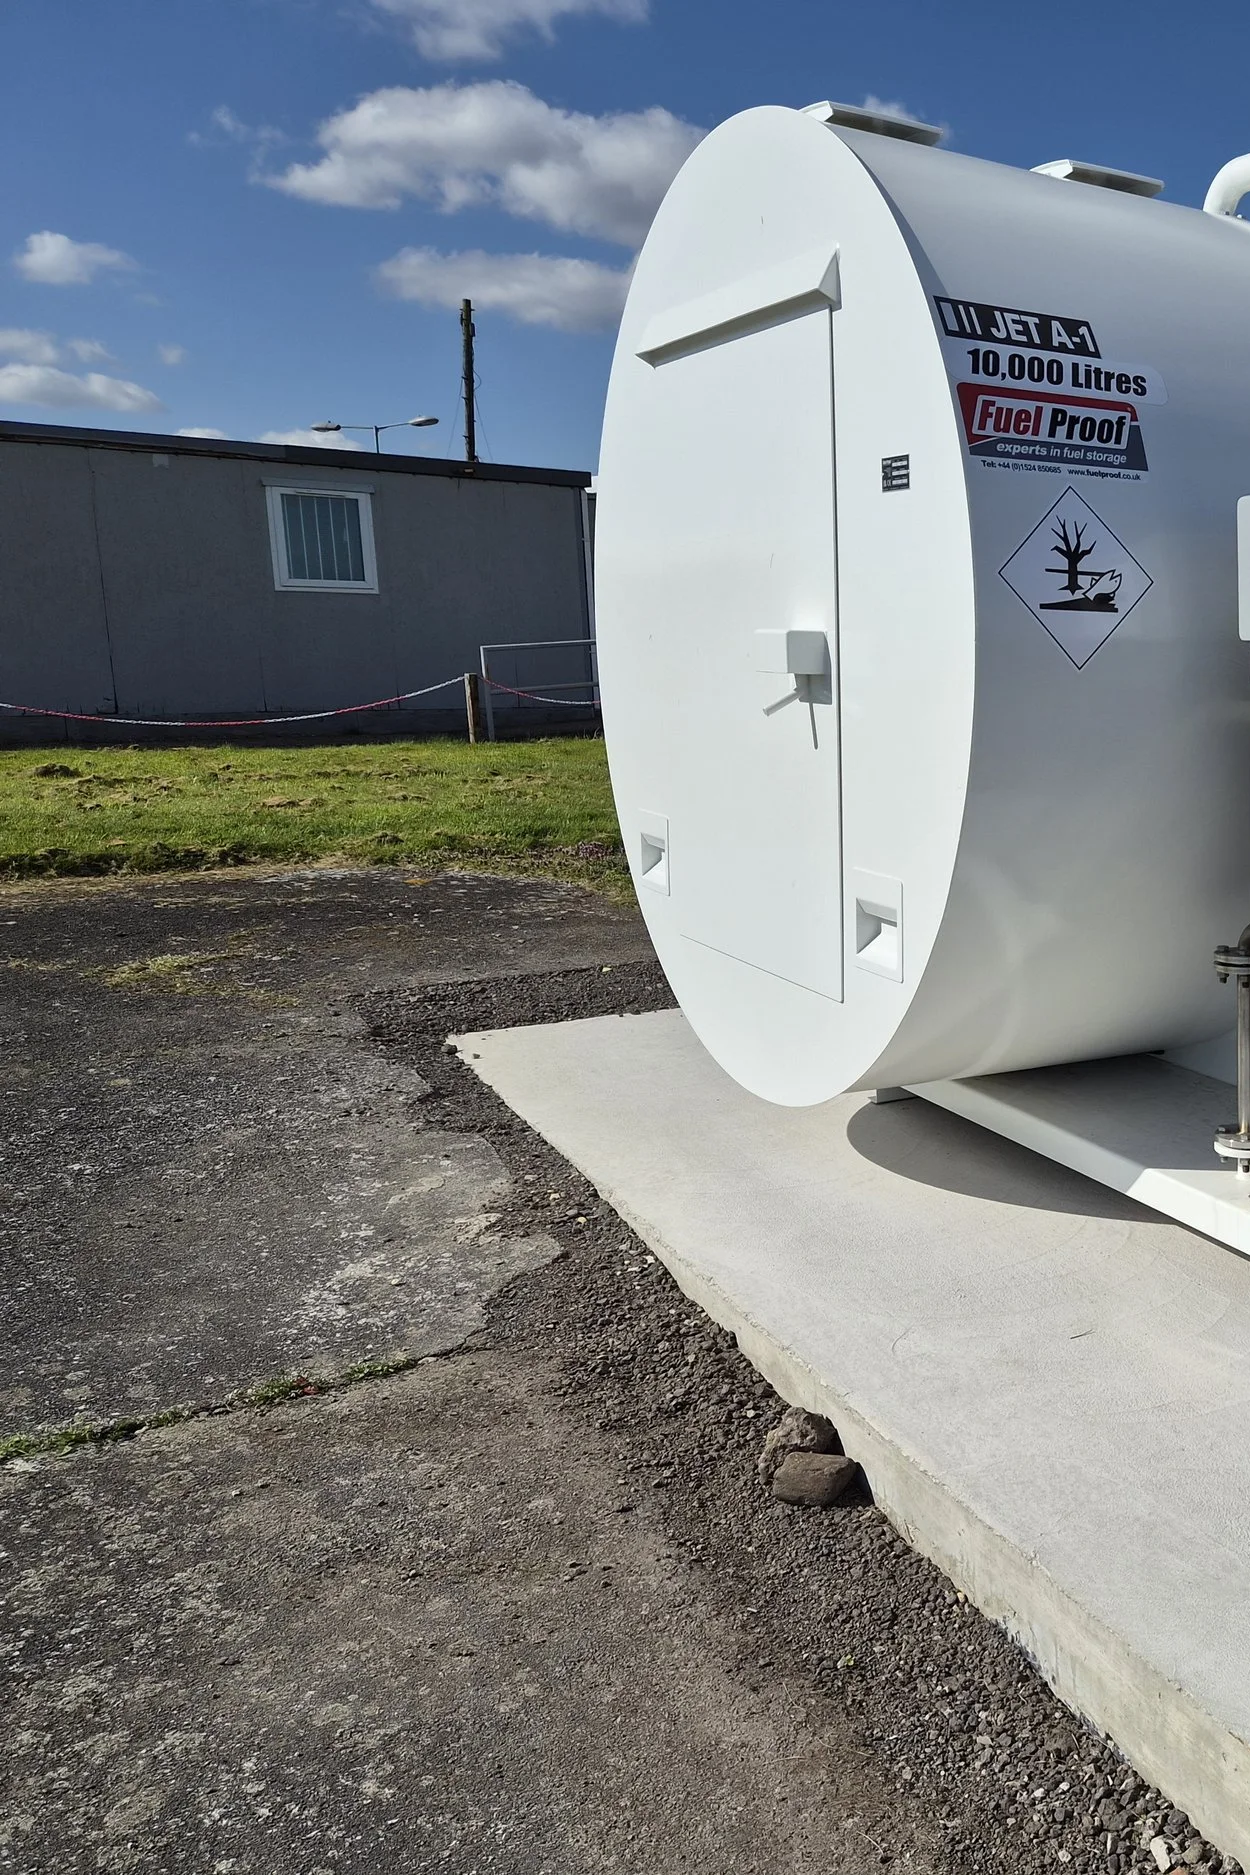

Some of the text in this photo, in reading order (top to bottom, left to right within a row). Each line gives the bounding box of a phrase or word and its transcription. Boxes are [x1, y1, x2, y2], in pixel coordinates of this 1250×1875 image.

[990, 311, 1095, 352] JET A-1
[967, 348, 1147, 397] 10,000 Litres
[977, 400, 1126, 445] Fuel Proof
[981, 459, 997, 468] Tel:
[1067, 468, 1141, 481] www.fuelproof.co.uk
[996, 443, 1127, 465] experts in fuel storage
